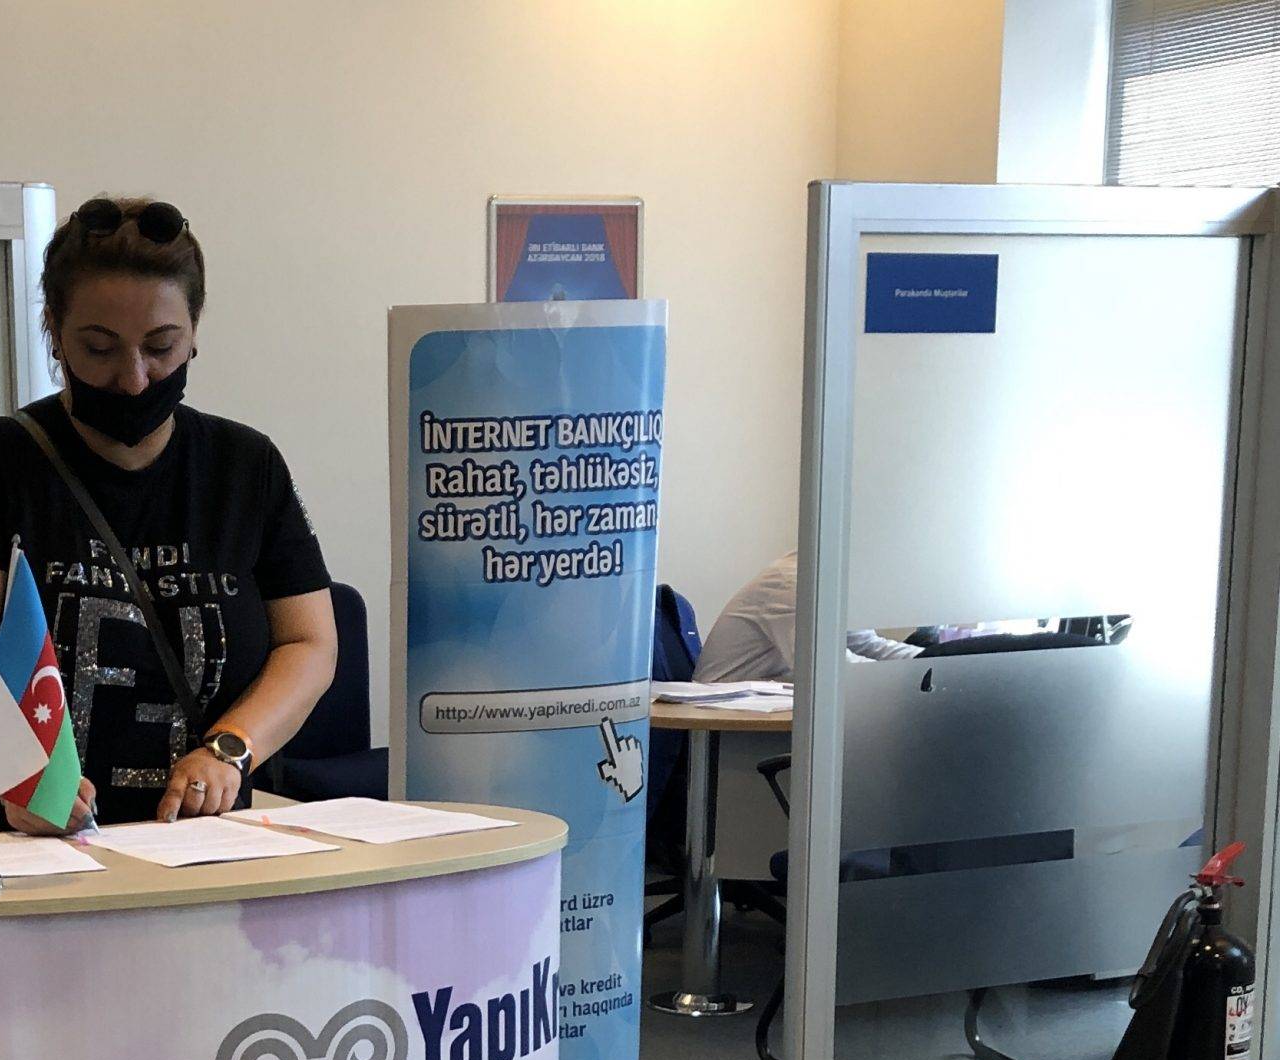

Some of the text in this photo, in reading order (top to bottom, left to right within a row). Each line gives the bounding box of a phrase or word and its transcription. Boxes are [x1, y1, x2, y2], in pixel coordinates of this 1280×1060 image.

[422, 414, 551, 450] İNTERNET
[429, 454, 658, 497] Rahat, təhlükəsiz,
[421, 504, 527, 541] sürətli,
[535, 504, 582, 535] hər
[89, 538, 190, 570] FNDI
[486, 542, 621, 585] hər yerdə!
[46, 561, 239, 598] FANTSTIC
[435, 696, 641, 723] http://www.yapikredi.com.az
[582, 893, 614, 909] üzrə
[581, 973, 622, 994] kredit
[572, 991, 633, 1017] haqqında
